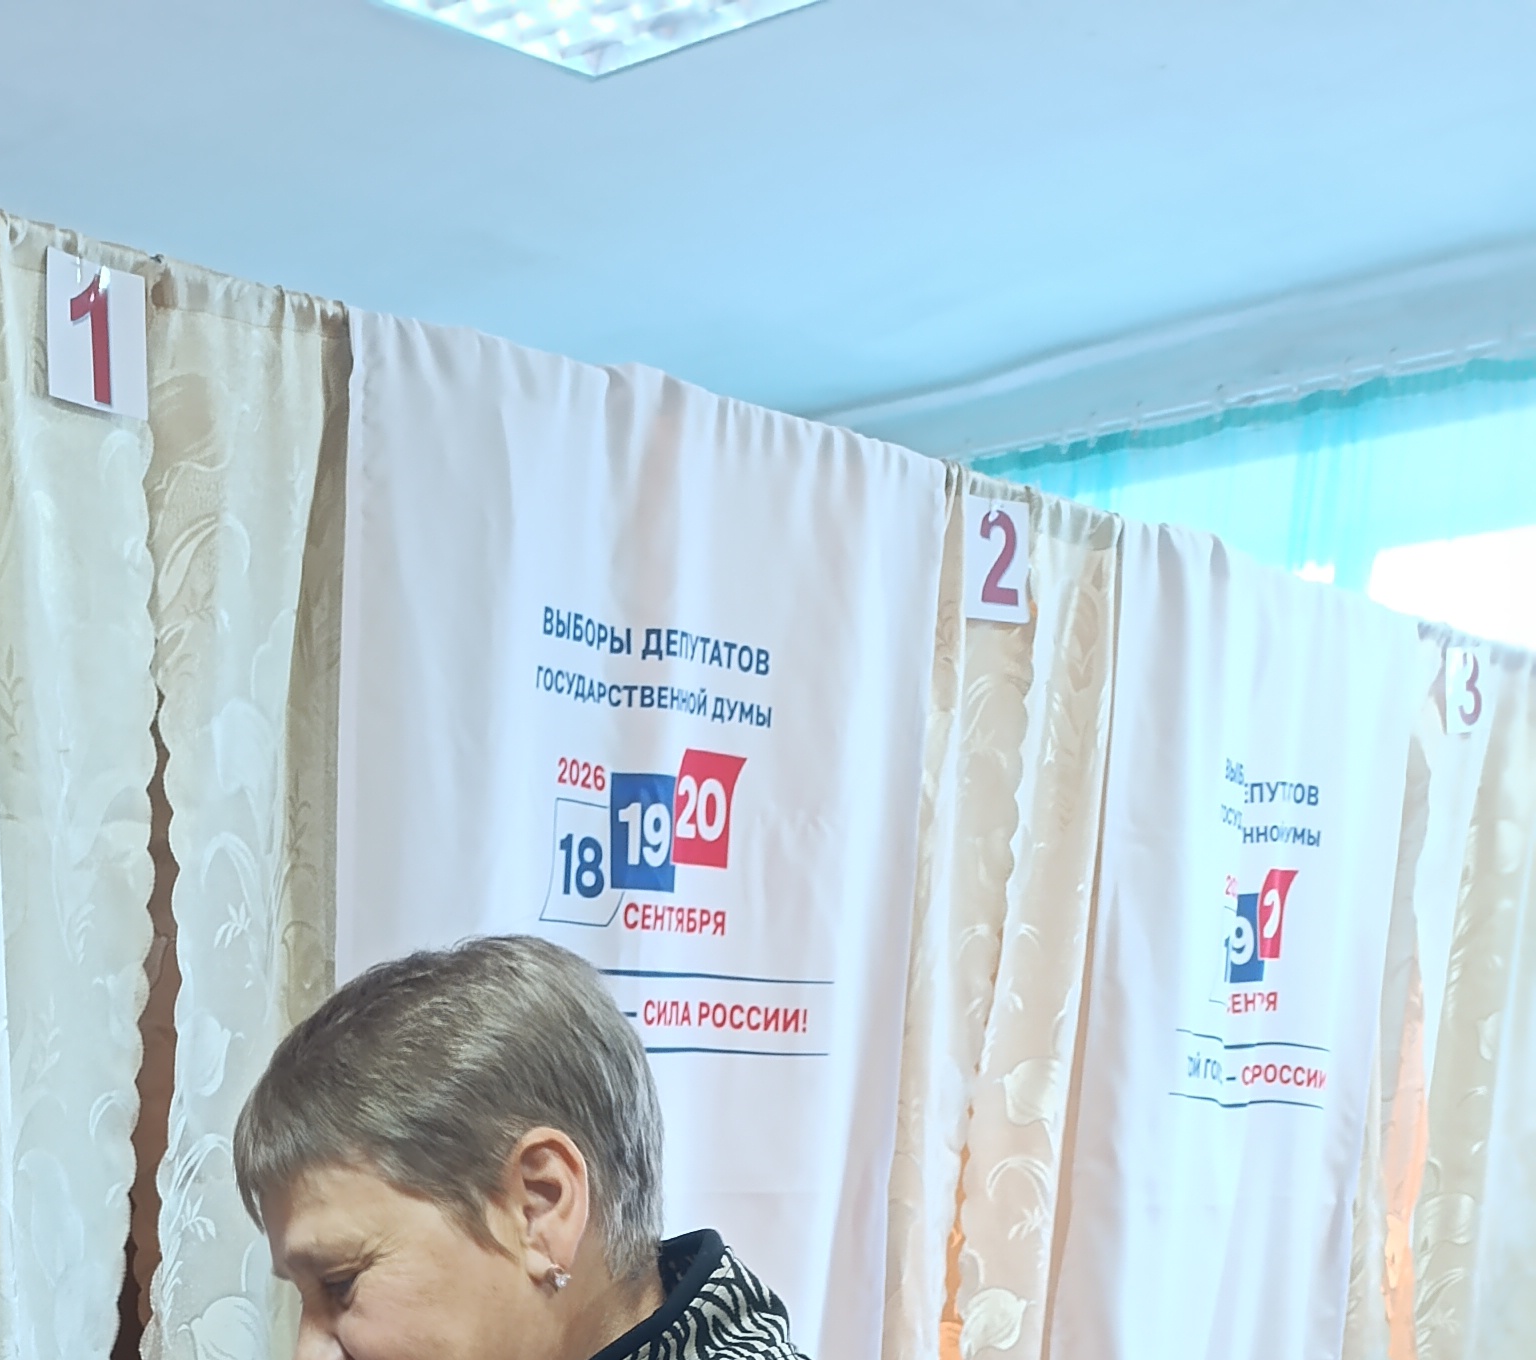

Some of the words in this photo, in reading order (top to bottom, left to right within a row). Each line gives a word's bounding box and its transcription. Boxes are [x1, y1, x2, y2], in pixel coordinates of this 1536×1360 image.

[69, 271, 112, 405] 1
[980, 510, 1019, 607] 2
[543, 605, 632, 656] ВЫБОРЫ
[641, 627, 771, 676] ДЕПУТАТОВ
[536, 664, 708, 717] ГОСУДАРСТВЕННОЙ
[711, 697, 773, 729] ДУМЫ
[1458, 651, 1482, 726] 3
[557, 756, 607, 792] 2026
[618, 801, 672, 868] 19
[675, 774, 728, 842] 20
[559, 832, 606, 899] 18
[623, 901, 727, 937] СЕНТЯБРЯ
[643, 999, 692, 1027] СИЛА
[697, 1001, 808, 1034] РОССИИ!
